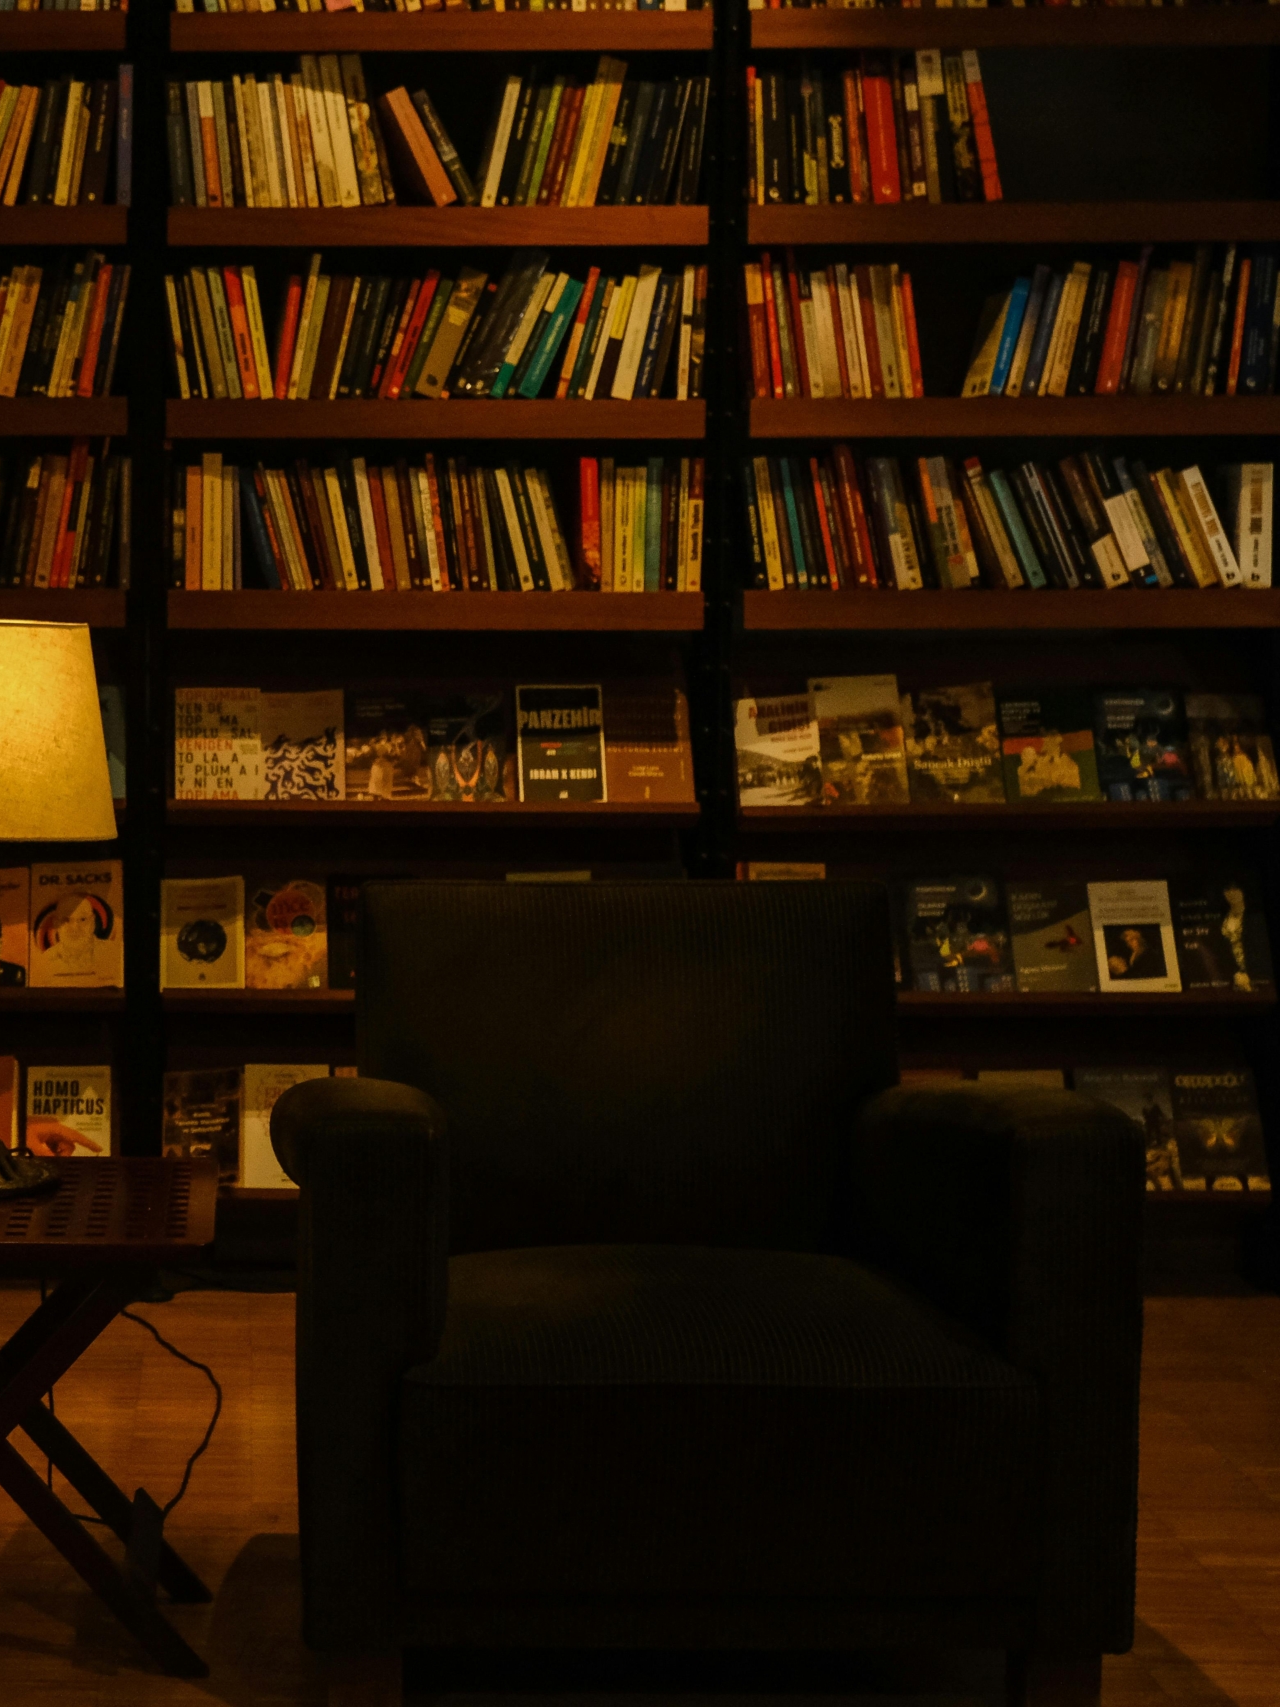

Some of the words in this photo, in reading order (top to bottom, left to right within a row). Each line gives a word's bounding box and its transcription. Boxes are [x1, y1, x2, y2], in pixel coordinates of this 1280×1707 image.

[65, 872, 113, 885] SACKS
[33, 1080, 80, 1097] HOMO
[32, 1098, 105, 1115] HAPTICUS
